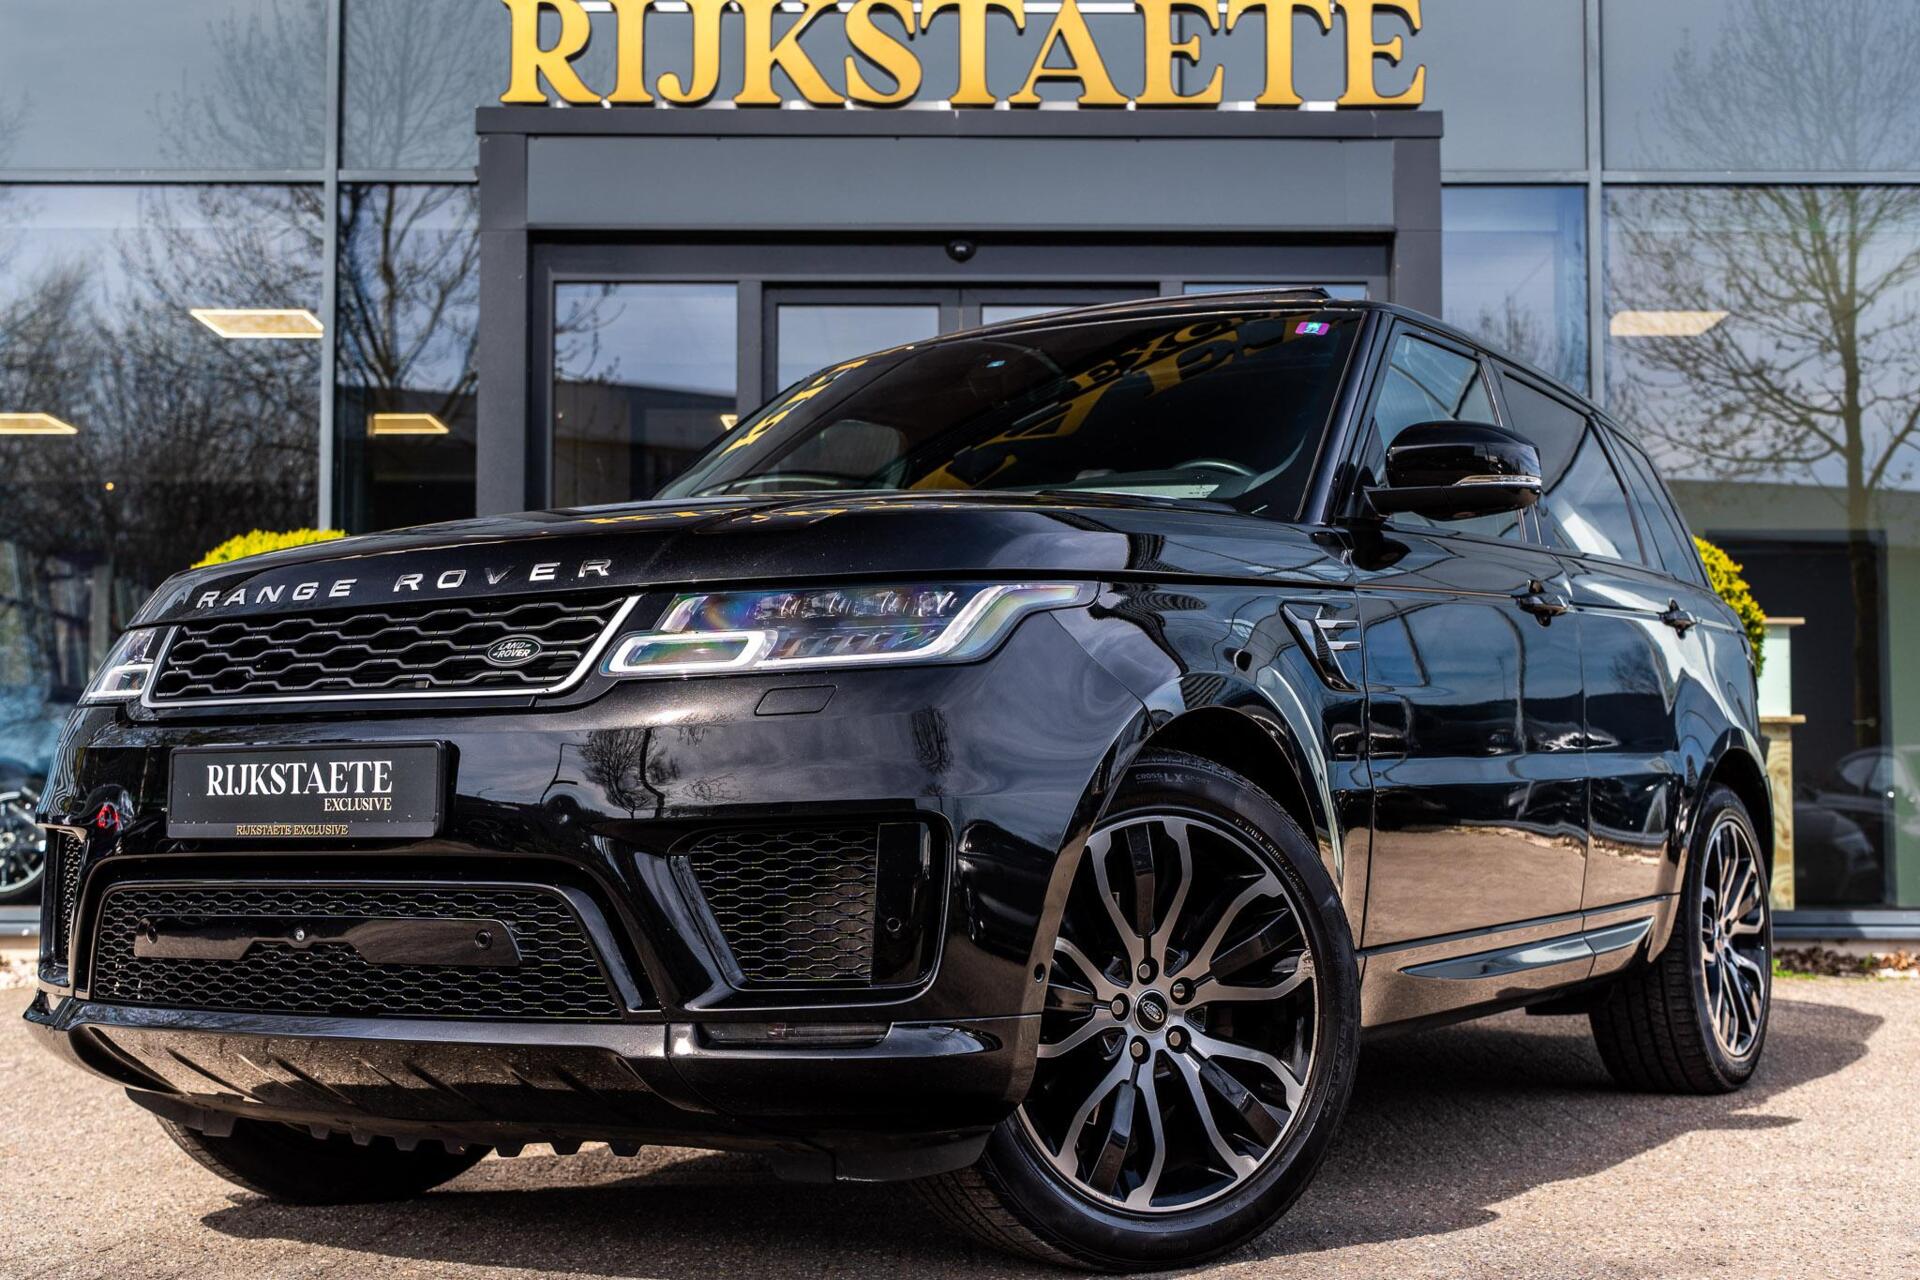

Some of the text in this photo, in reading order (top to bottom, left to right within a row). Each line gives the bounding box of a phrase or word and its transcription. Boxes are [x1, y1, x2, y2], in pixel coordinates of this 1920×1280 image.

[500, 0, 1427, 107] RIJKSTAETE
[196, 559, 612, 609] RANGE ROVER
[497, 648, 531, 658] ROVER
[498, 642, 526, 650] LAND
[206, 760, 393, 797] RIJKSTAETE
[324, 798, 392, 812] EXCLUSIVE
[236, 823, 349, 836] RIJKSTAETE EXCLUSIVE
